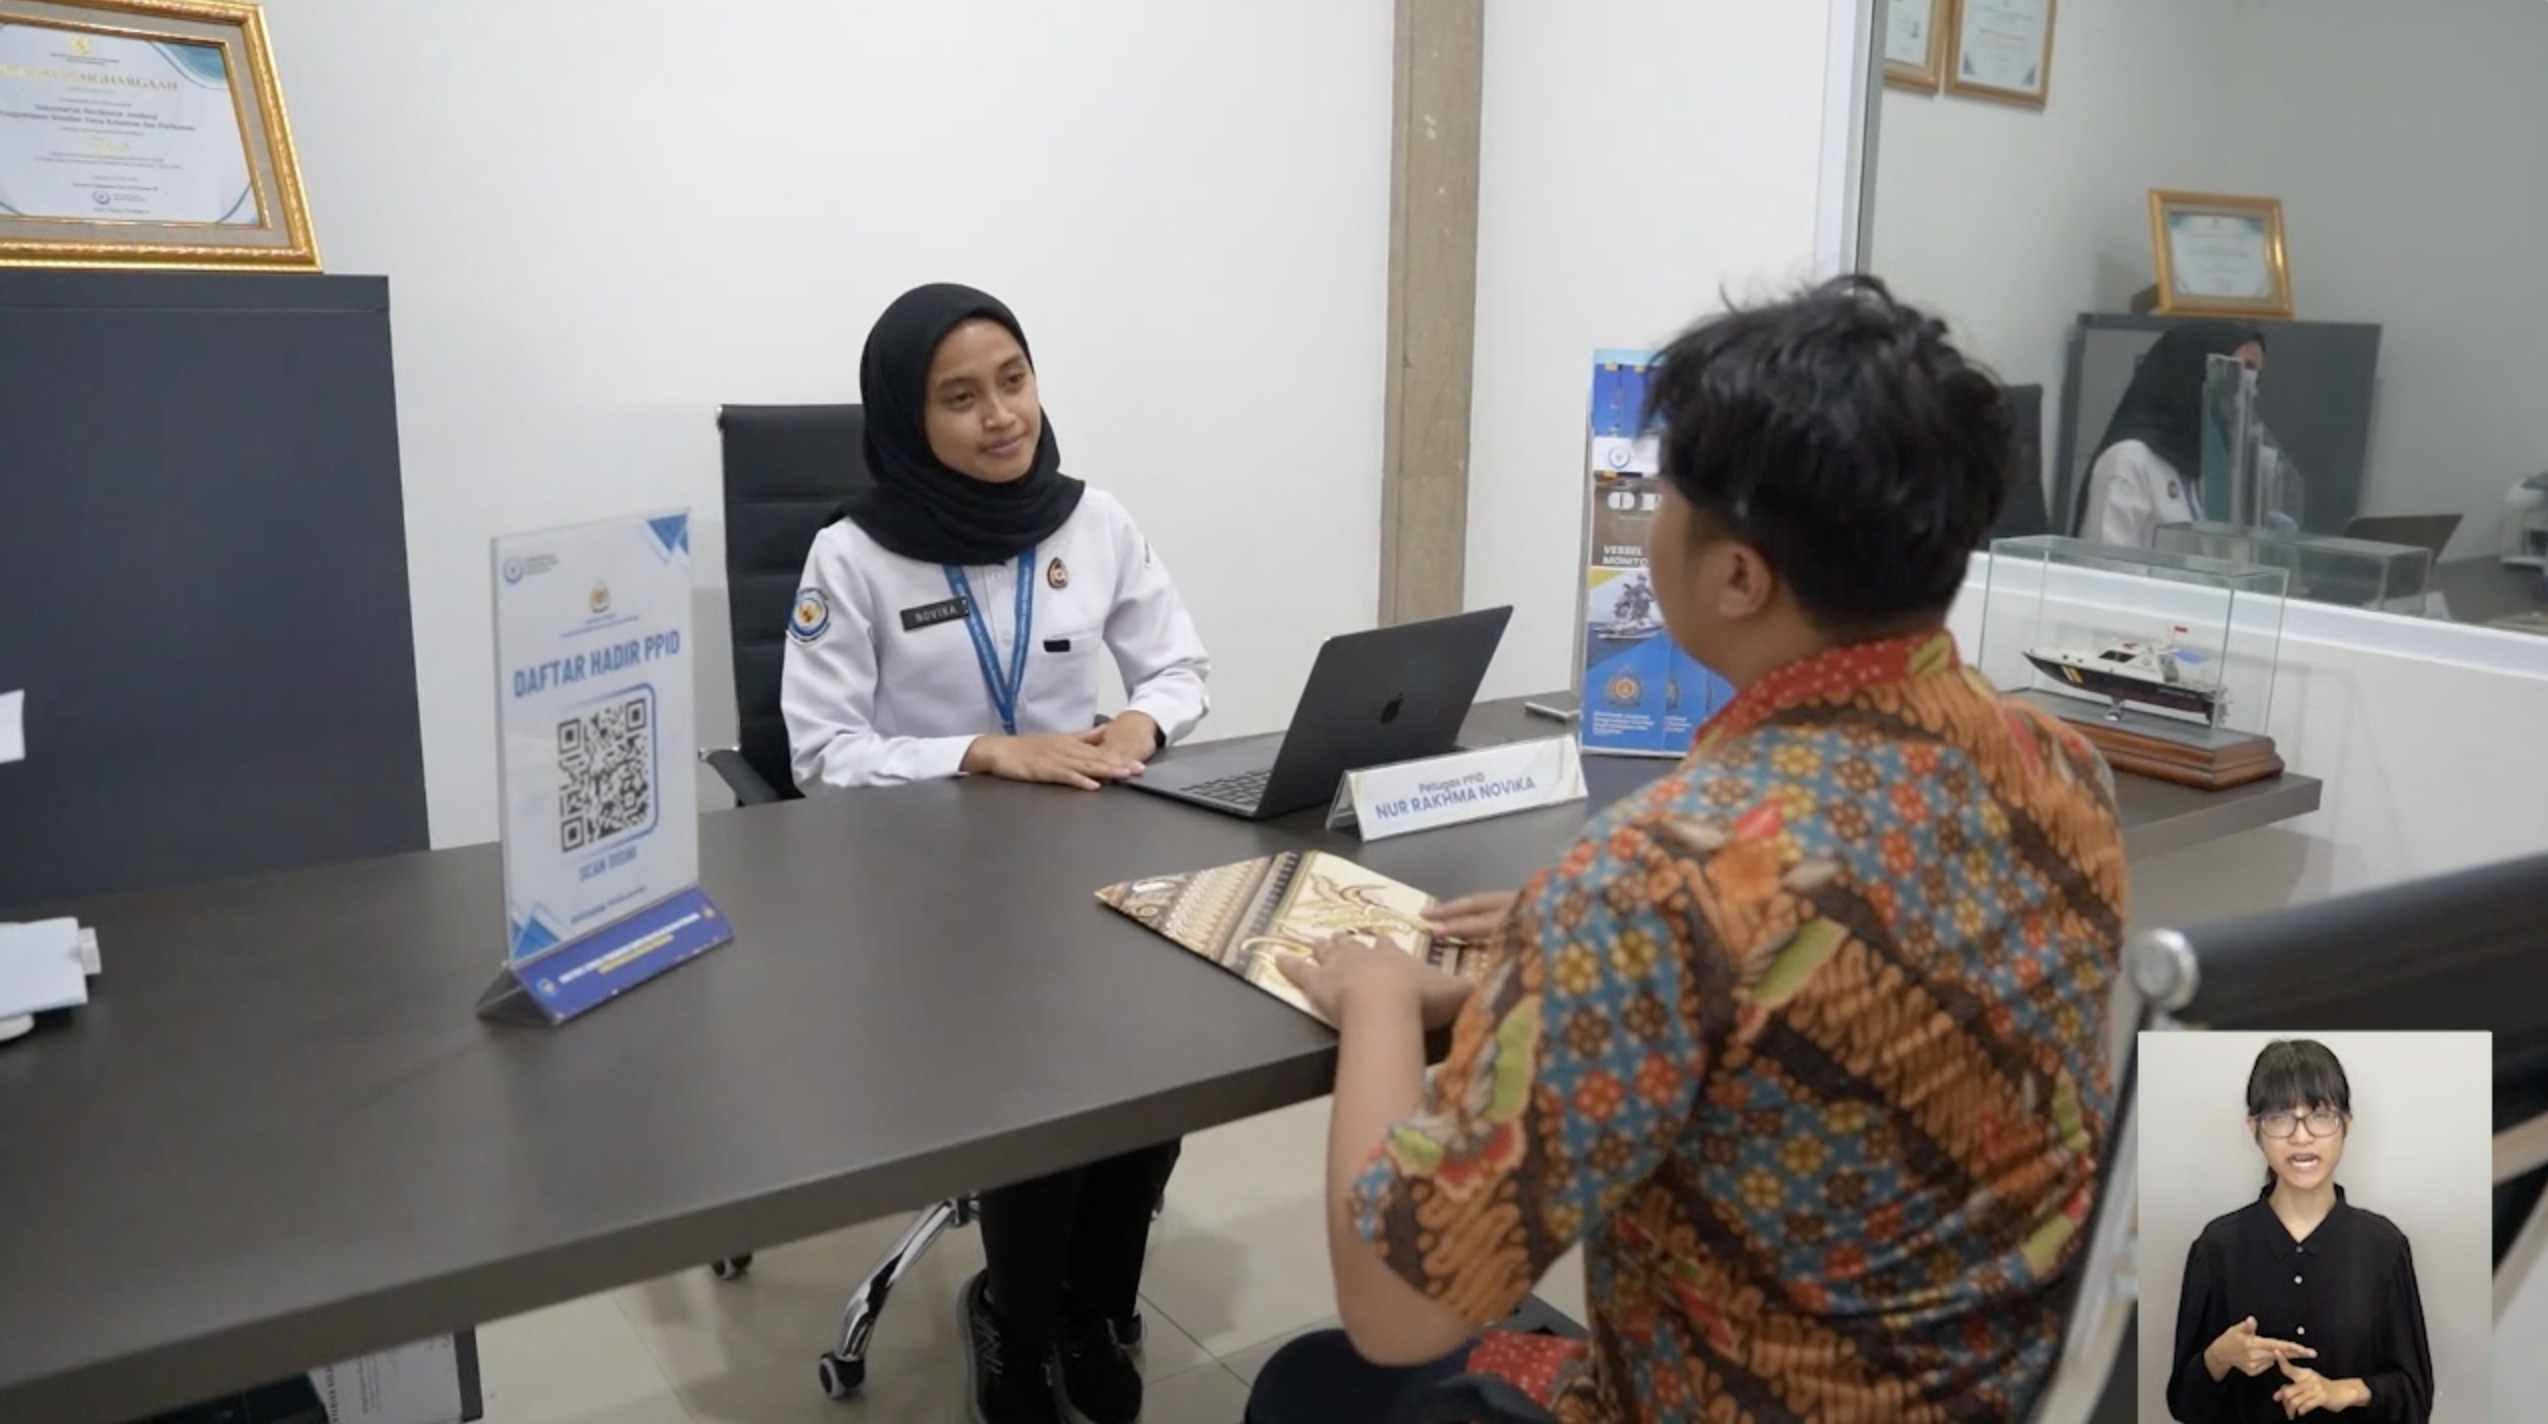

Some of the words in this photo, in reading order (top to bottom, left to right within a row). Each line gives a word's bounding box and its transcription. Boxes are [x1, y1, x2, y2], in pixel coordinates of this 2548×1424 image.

[1603, 545, 1642, 557] VESSEL
[914, 605, 958, 623] NOVIKA
[513, 654, 586, 698] DAFTAR
[590, 639, 640, 677] HADIR
[644, 629, 681, 661] PPID
[1418, 778, 1461, 795] Petugas
[1375, 800, 1409, 819] NUR
[1411, 787, 1478, 812] RAKHMA
[1479, 776, 1537, 799] NOVIKA
[579, 858, 606, 881] SCAN
